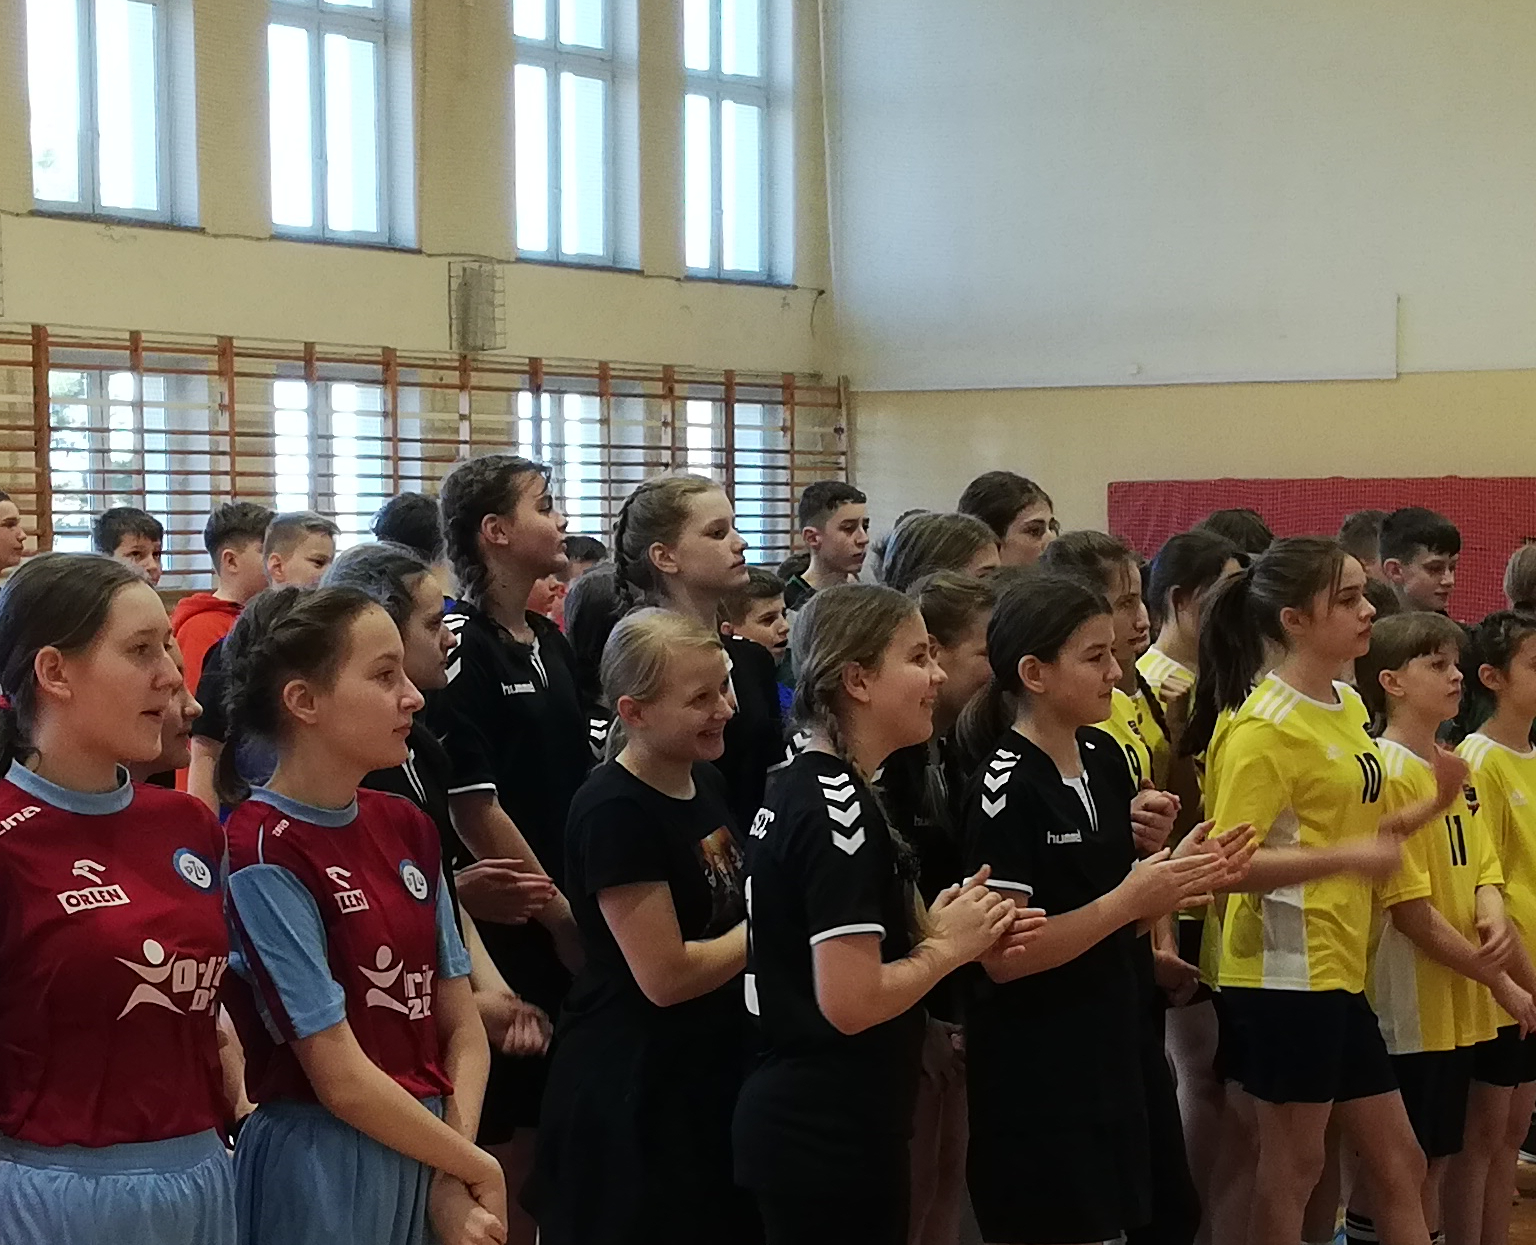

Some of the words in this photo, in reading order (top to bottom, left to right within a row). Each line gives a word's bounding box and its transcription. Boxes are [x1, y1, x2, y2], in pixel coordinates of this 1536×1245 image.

[1354, 752, 1382, 804] 10
[1445, 815, 1468, 867] 11
[184, 860, 206, 881] PZU
[63, 887, 125, 909] ORLEN
